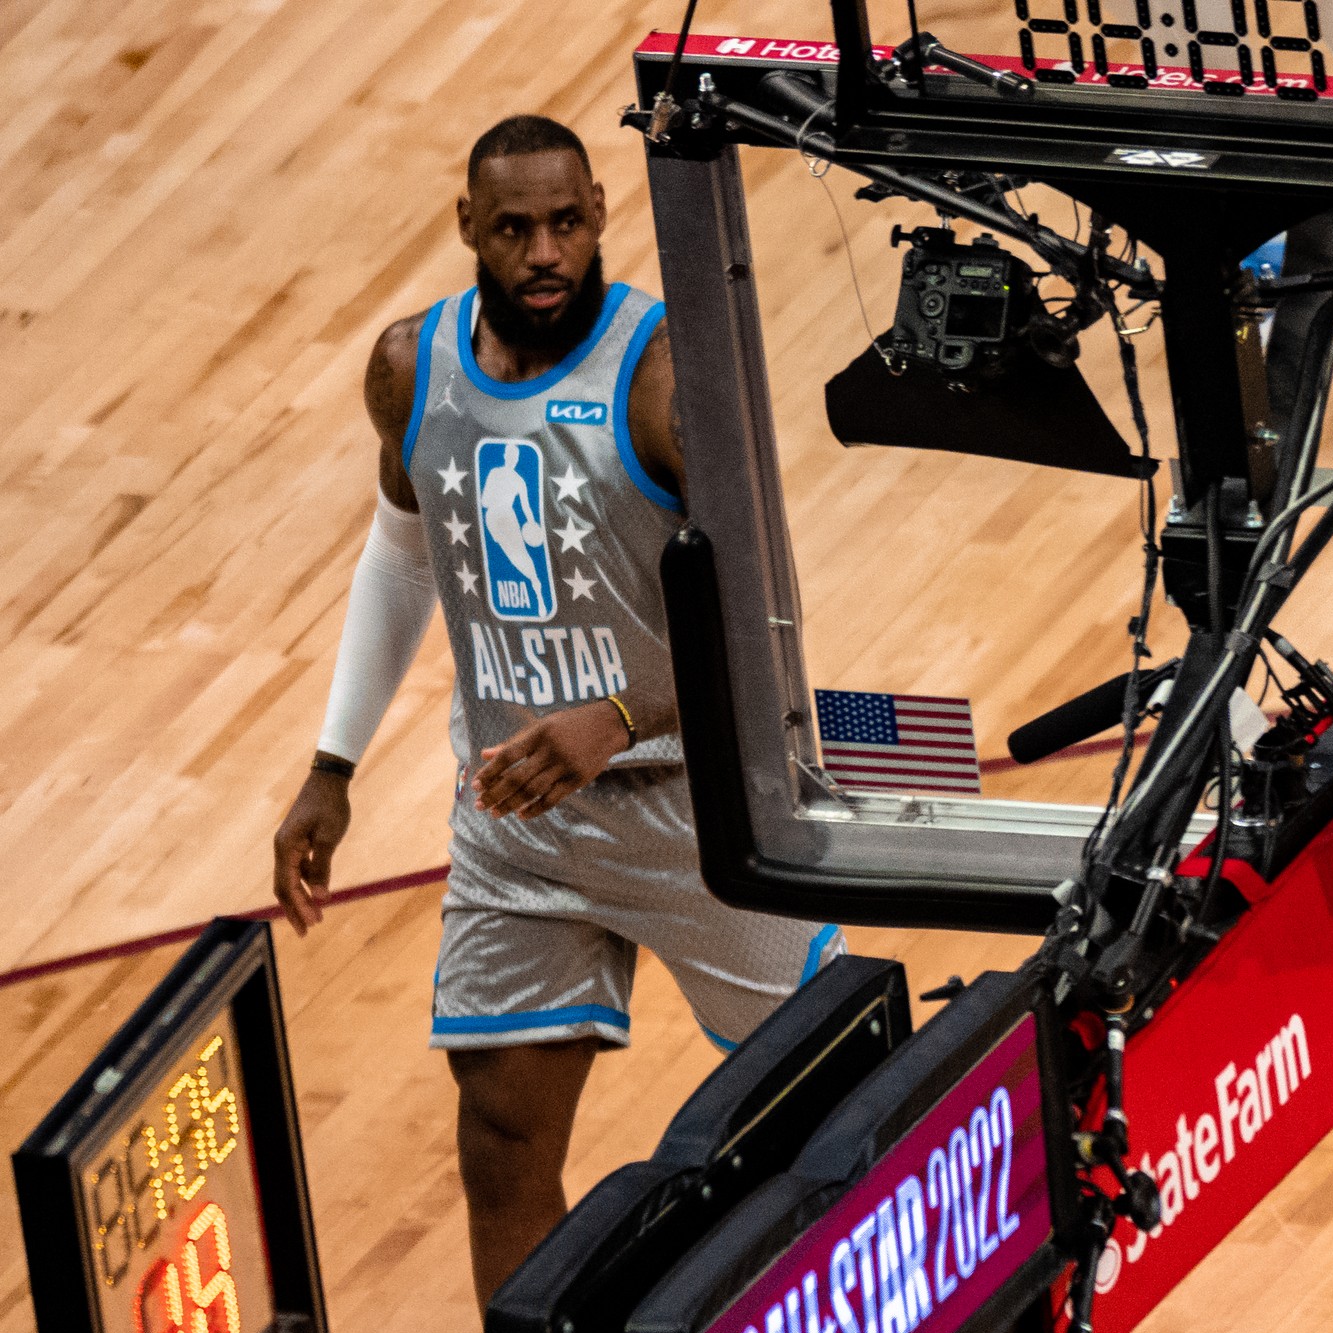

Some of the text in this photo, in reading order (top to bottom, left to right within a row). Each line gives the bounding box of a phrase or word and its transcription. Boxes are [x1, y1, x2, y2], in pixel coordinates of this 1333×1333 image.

[497, 580, 531, 610] NBA
[470, 621, 629, 707] ALL-STAR
[927, 1085, 1020, 1304] 2022
